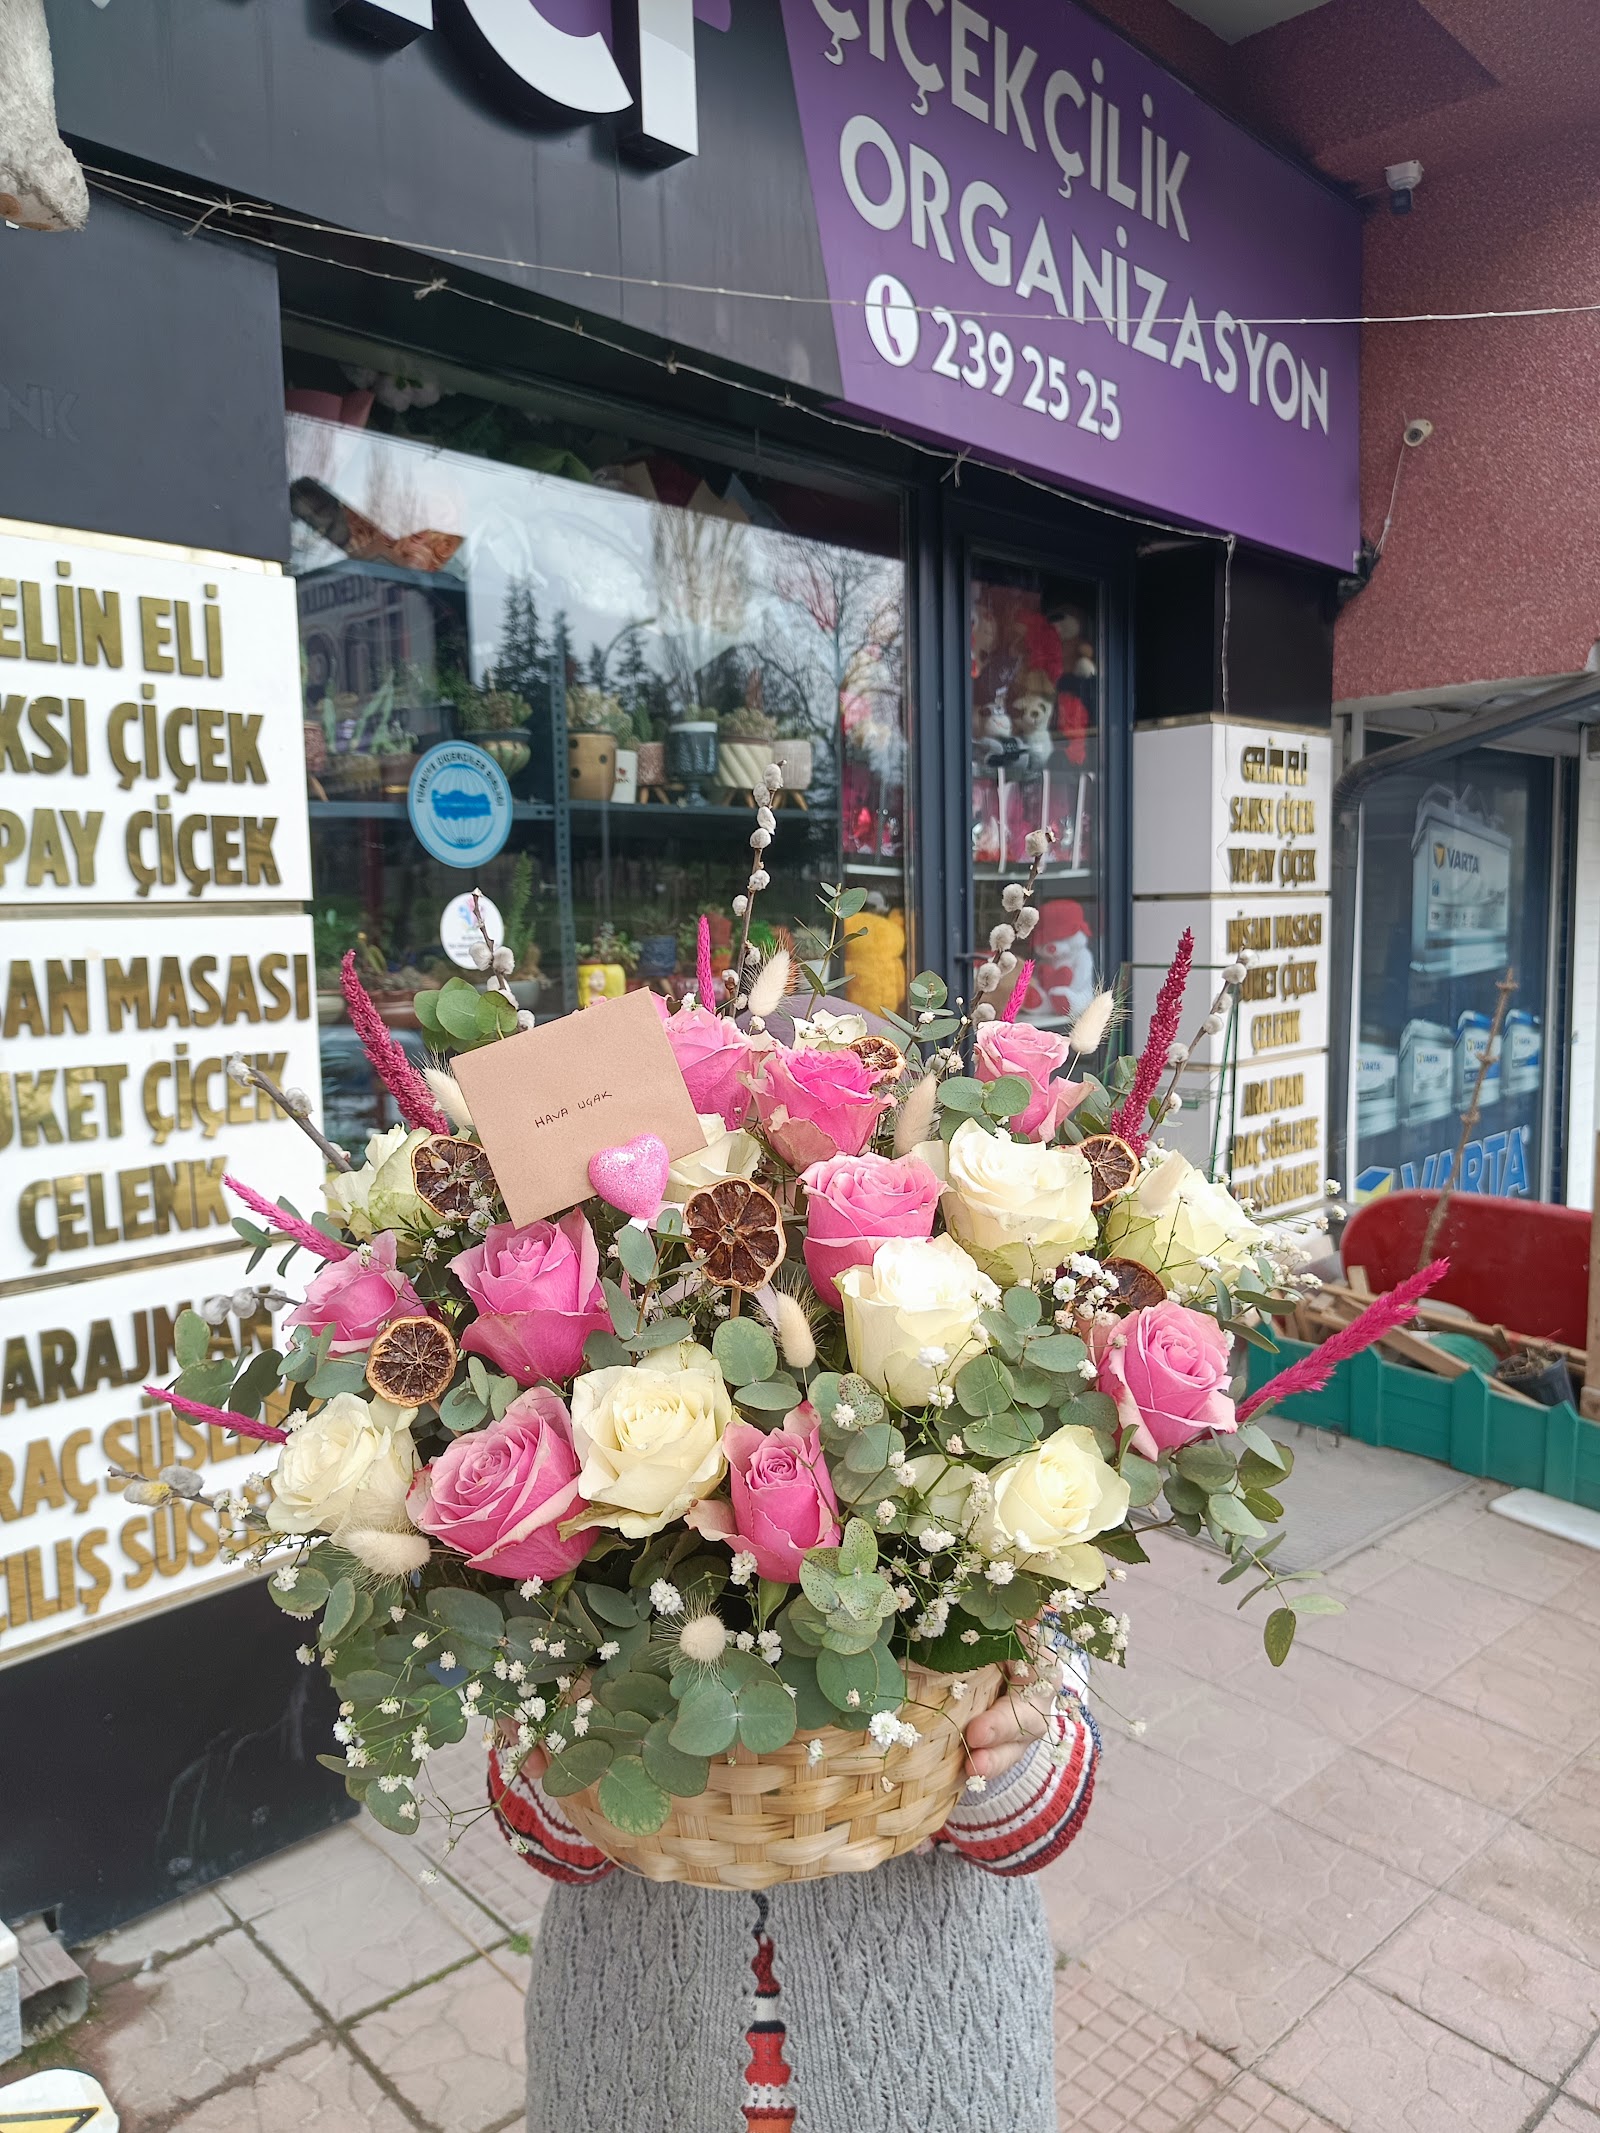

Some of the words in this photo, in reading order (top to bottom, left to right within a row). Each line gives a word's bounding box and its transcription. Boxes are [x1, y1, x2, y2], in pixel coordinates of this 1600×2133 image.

[839, 115, 1328, 435] ORGANİZASYON
[930, 306, 1014, 397] 239
[1020, 345, 1070, 421] 25
[1076, 369, 1121, 441] 25
[0, 561, 124, 668] ELİN
[139, 584, 223, 678] ELİ
[108, 683, 268, 793] ÇİÇEK
[0, 808, 104, 886] PAY
[126, 795, 281, 897] ÇİÇEK
[1447, 847, 1480, 874] VARTA
[104, 954, 310, 1032] MASASI
[143, 1043, 289, 1145] ÇİÇEK
[534, 1108, 569, 1128] HAVA
[19, 1156, 231, 1267] ÇELENK
[0, 1528, 112, 1634] ILIŞ
